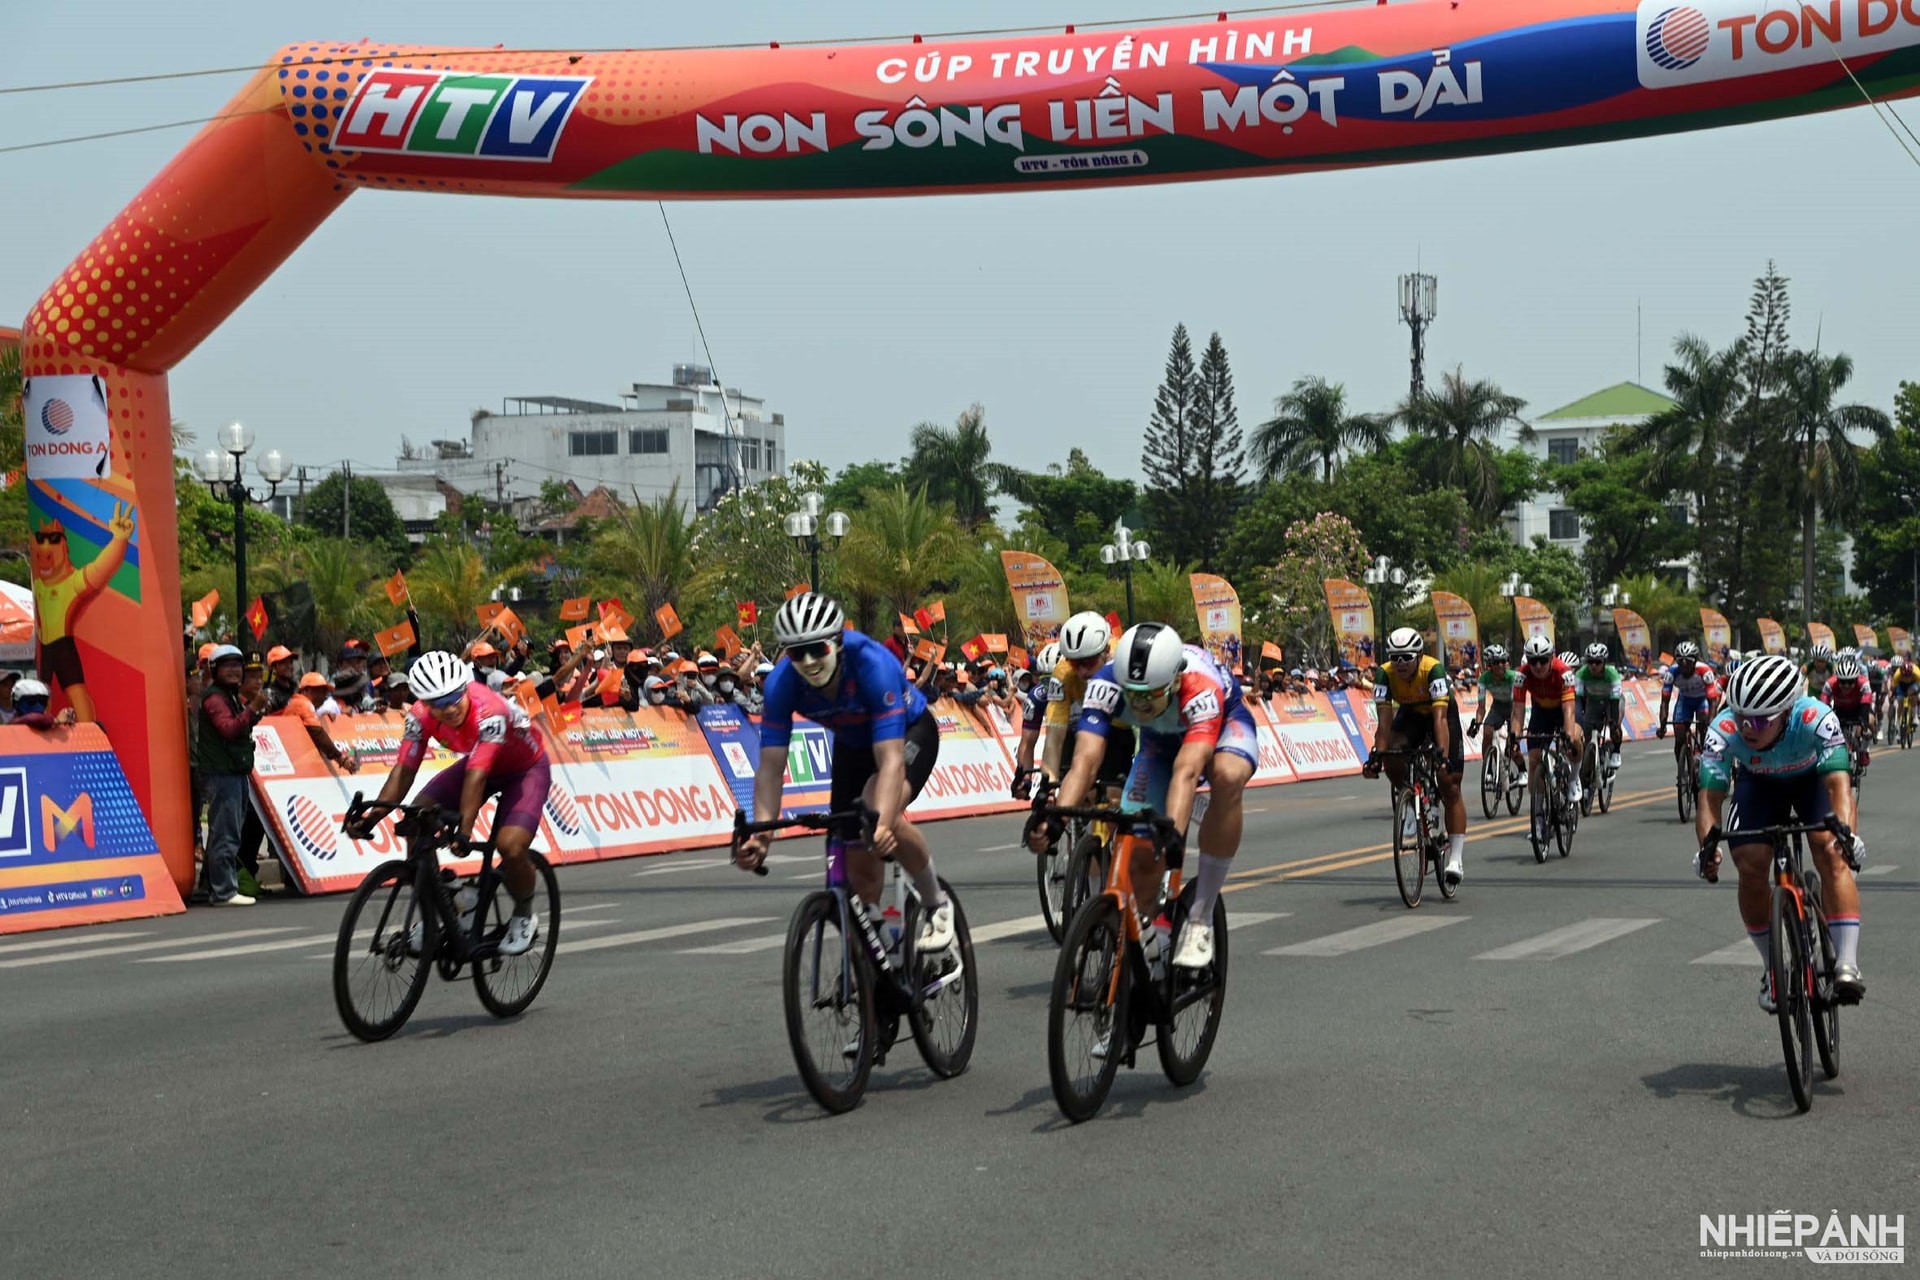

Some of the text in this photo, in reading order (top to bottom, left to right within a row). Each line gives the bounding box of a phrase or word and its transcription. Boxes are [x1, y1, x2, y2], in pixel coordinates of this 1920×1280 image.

[1717, 0, 1842, 60] TON
[876, 27, 1313, 84] CÚP TRUYỀN HÌNH
[348, 82, 571, 144] HTV
[696, 48, 1483, 154] NON SÔNG LIỀN MỘT DẢI
[1021, 161, 1048, 171] HTV
[27, 443, 47, 457] TON
[48, 441, 92, 456] DONG
[1088, 684, 1119, 705] 107
[784, 738, 828, 775] TV
[949, 763, 1002, 794] DONG
[574, 791, 643, 832] TON
[632, 784, 712, 826] DONG
[708, 783, 735, 819] A
